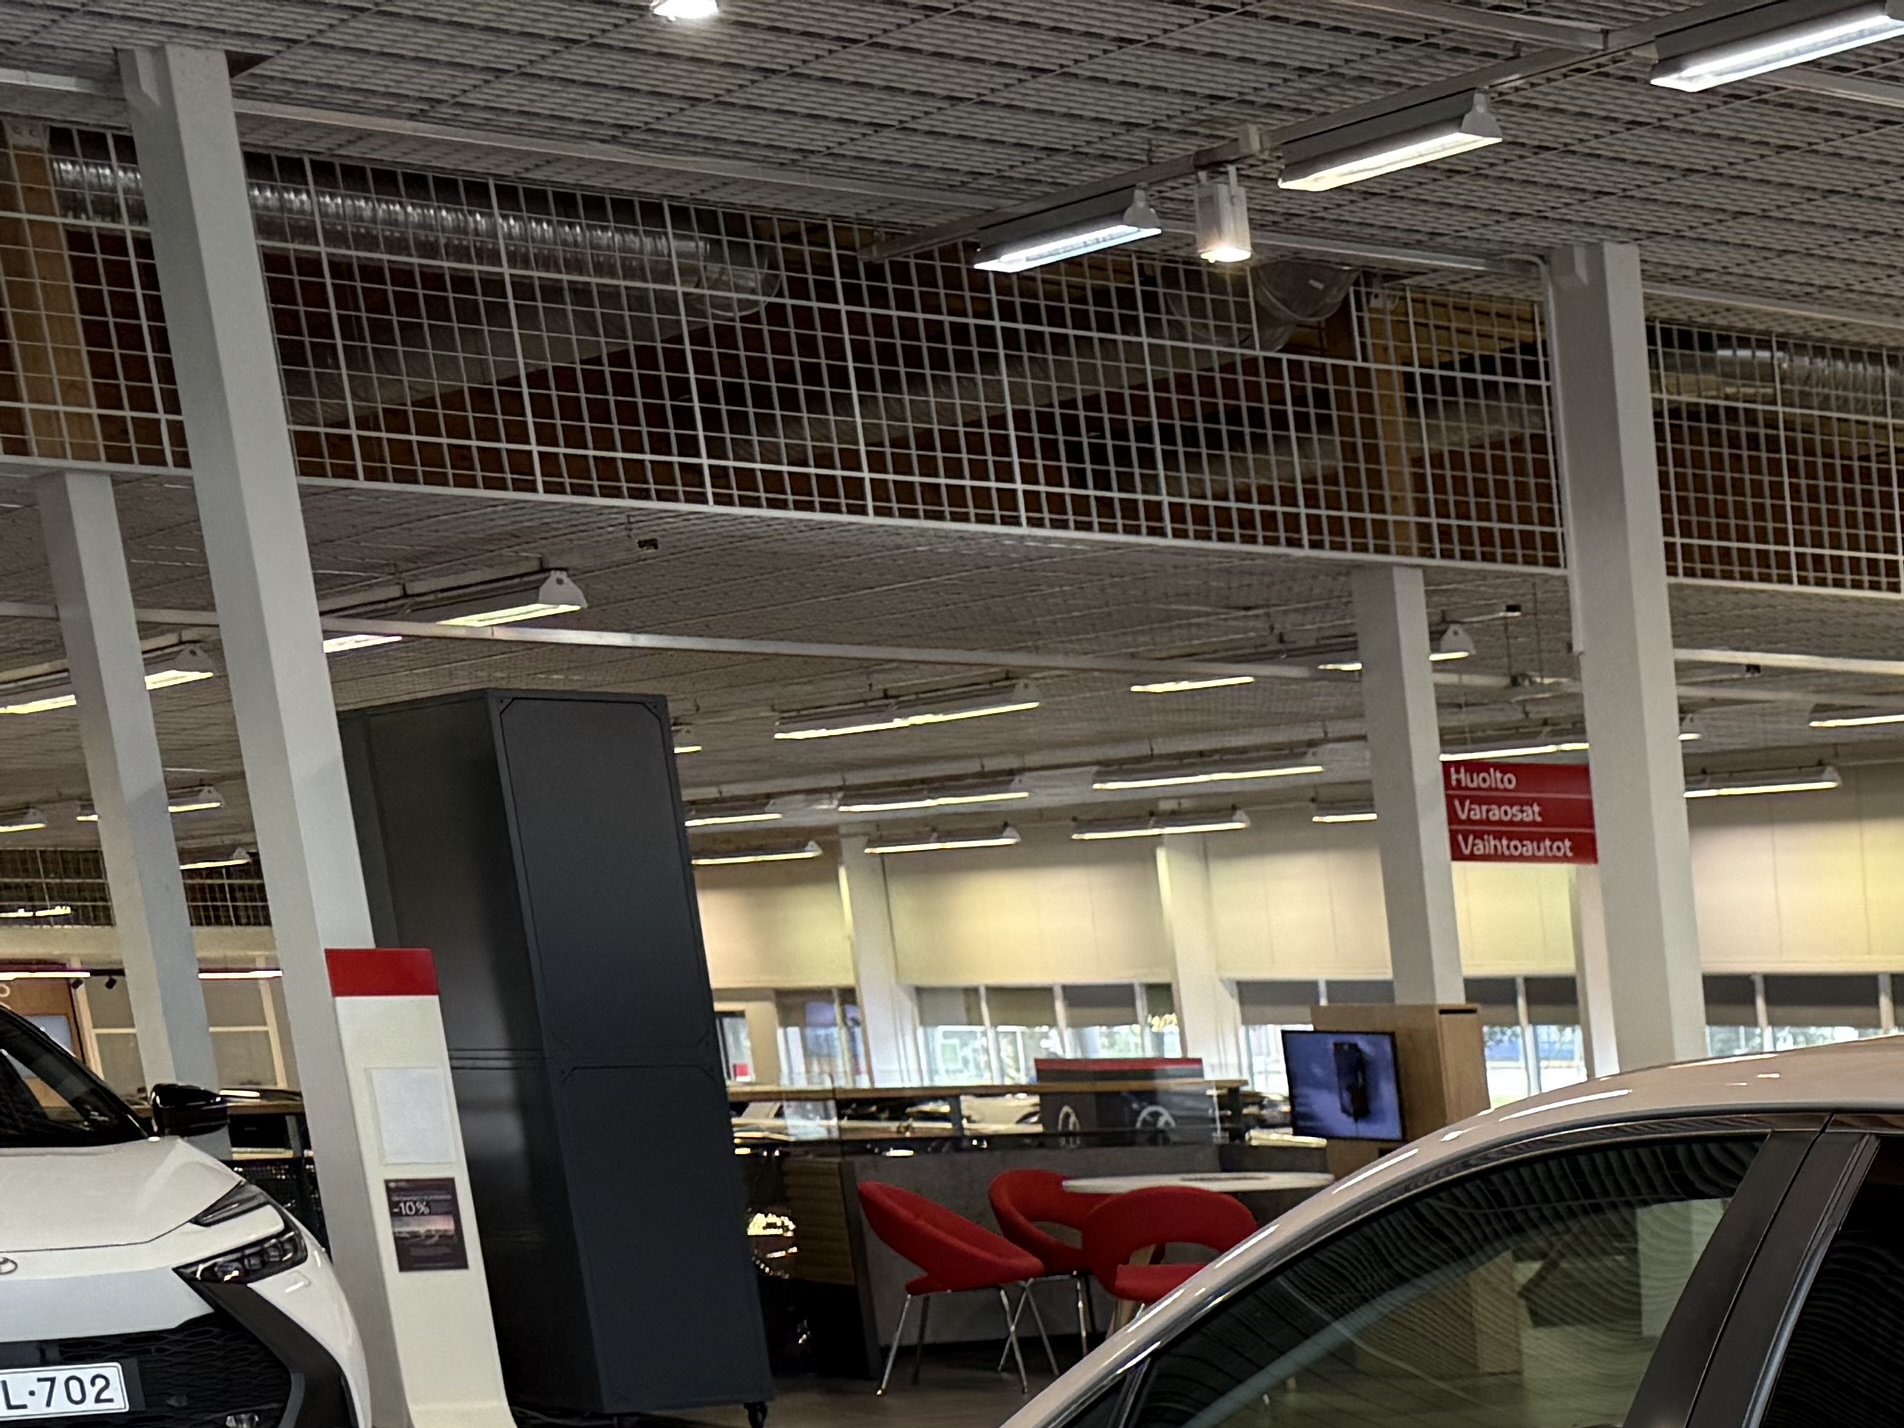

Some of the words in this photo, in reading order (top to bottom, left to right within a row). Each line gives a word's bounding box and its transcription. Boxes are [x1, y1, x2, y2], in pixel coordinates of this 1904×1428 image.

[1450, 765, 1517, 789] Huolto
[1454, 799, 1542, 823] Varaosat
[1458, 833, 1573, 857] Vaihtoautot
[392, 1200, 431, 1216] -10%
